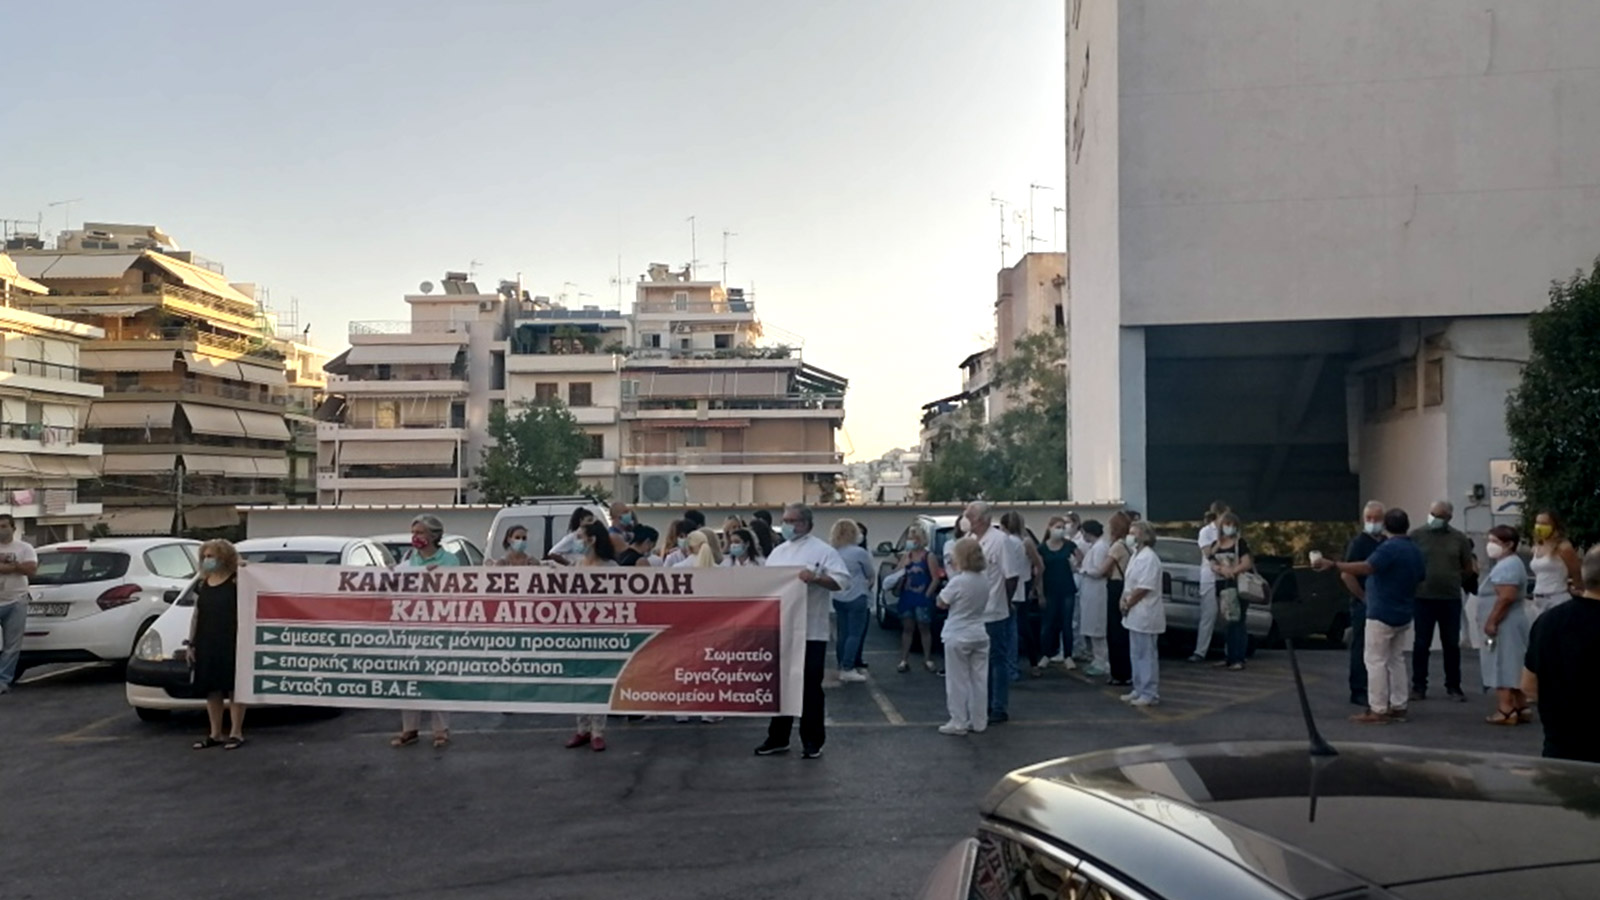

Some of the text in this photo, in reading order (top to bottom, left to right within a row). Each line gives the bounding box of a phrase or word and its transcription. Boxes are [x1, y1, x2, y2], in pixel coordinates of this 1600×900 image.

[1493, 487, 1524, 499] Εισαγ
[338, 571, 694, 594] ΚΑΝΕΝΑΣ ΣΕ ΑΝΑΣΤΟΛΗ
[390, 600, 637, 624] ΚΑΜΙΑ ΑΠΟΛΥΣΗ
[280, 628, 631, 653] άμεσες προσλήψεις μόνιμου προσωπικού
[279, 654, 564, 675] επαρκής κρατική χρηματοδότηση
[704, 648, 773, 664] Σωματείο
[280, 676, 422, 696] ένταξη στα Β.Α.Ε.
[674, 668, 773, 685] Εργαζομένων
[620, 688, 773, 706] Νοσοκομείου Μεταξά
